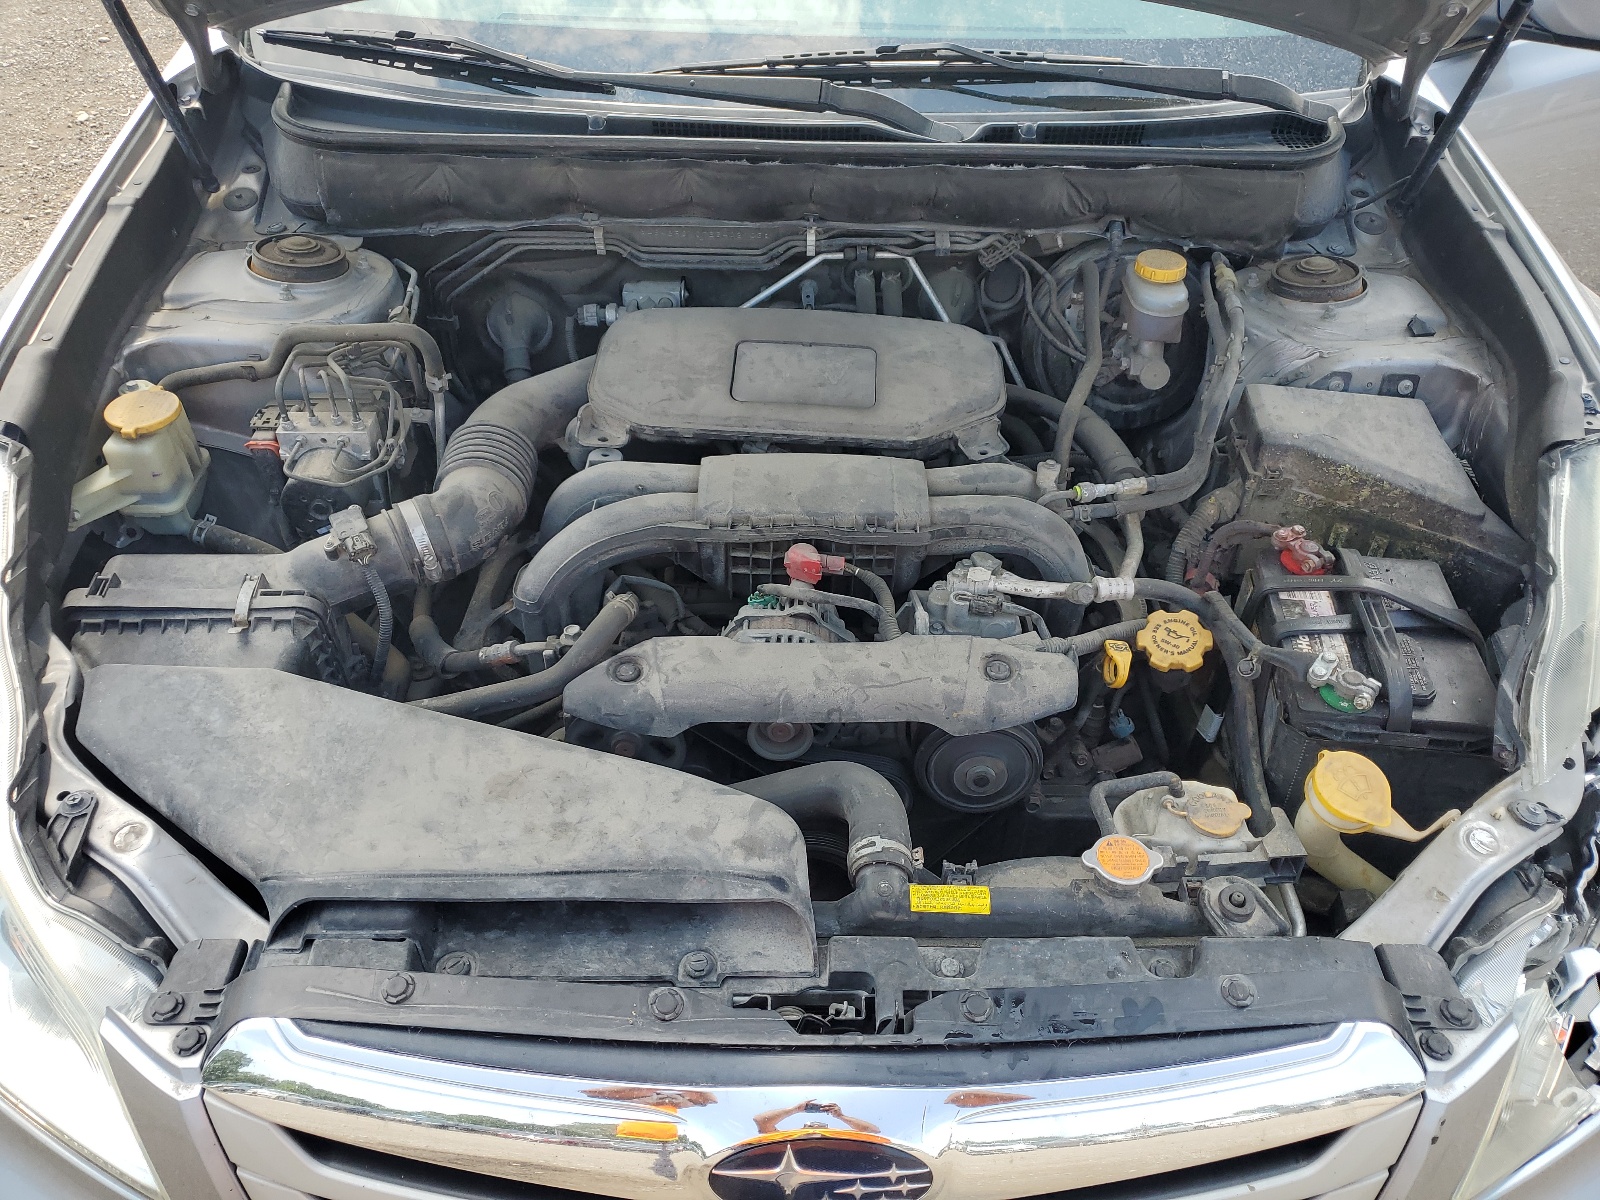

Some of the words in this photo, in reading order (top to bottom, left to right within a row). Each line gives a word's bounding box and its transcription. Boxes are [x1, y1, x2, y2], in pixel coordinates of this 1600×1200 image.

[1163, 618, 1190, 627] ENGINE
[1189, 626, 1198, 636] OIL
[1160, 638, 1180, 649] 5W-30
[1176, 639, 1199, 656] MANUAL
